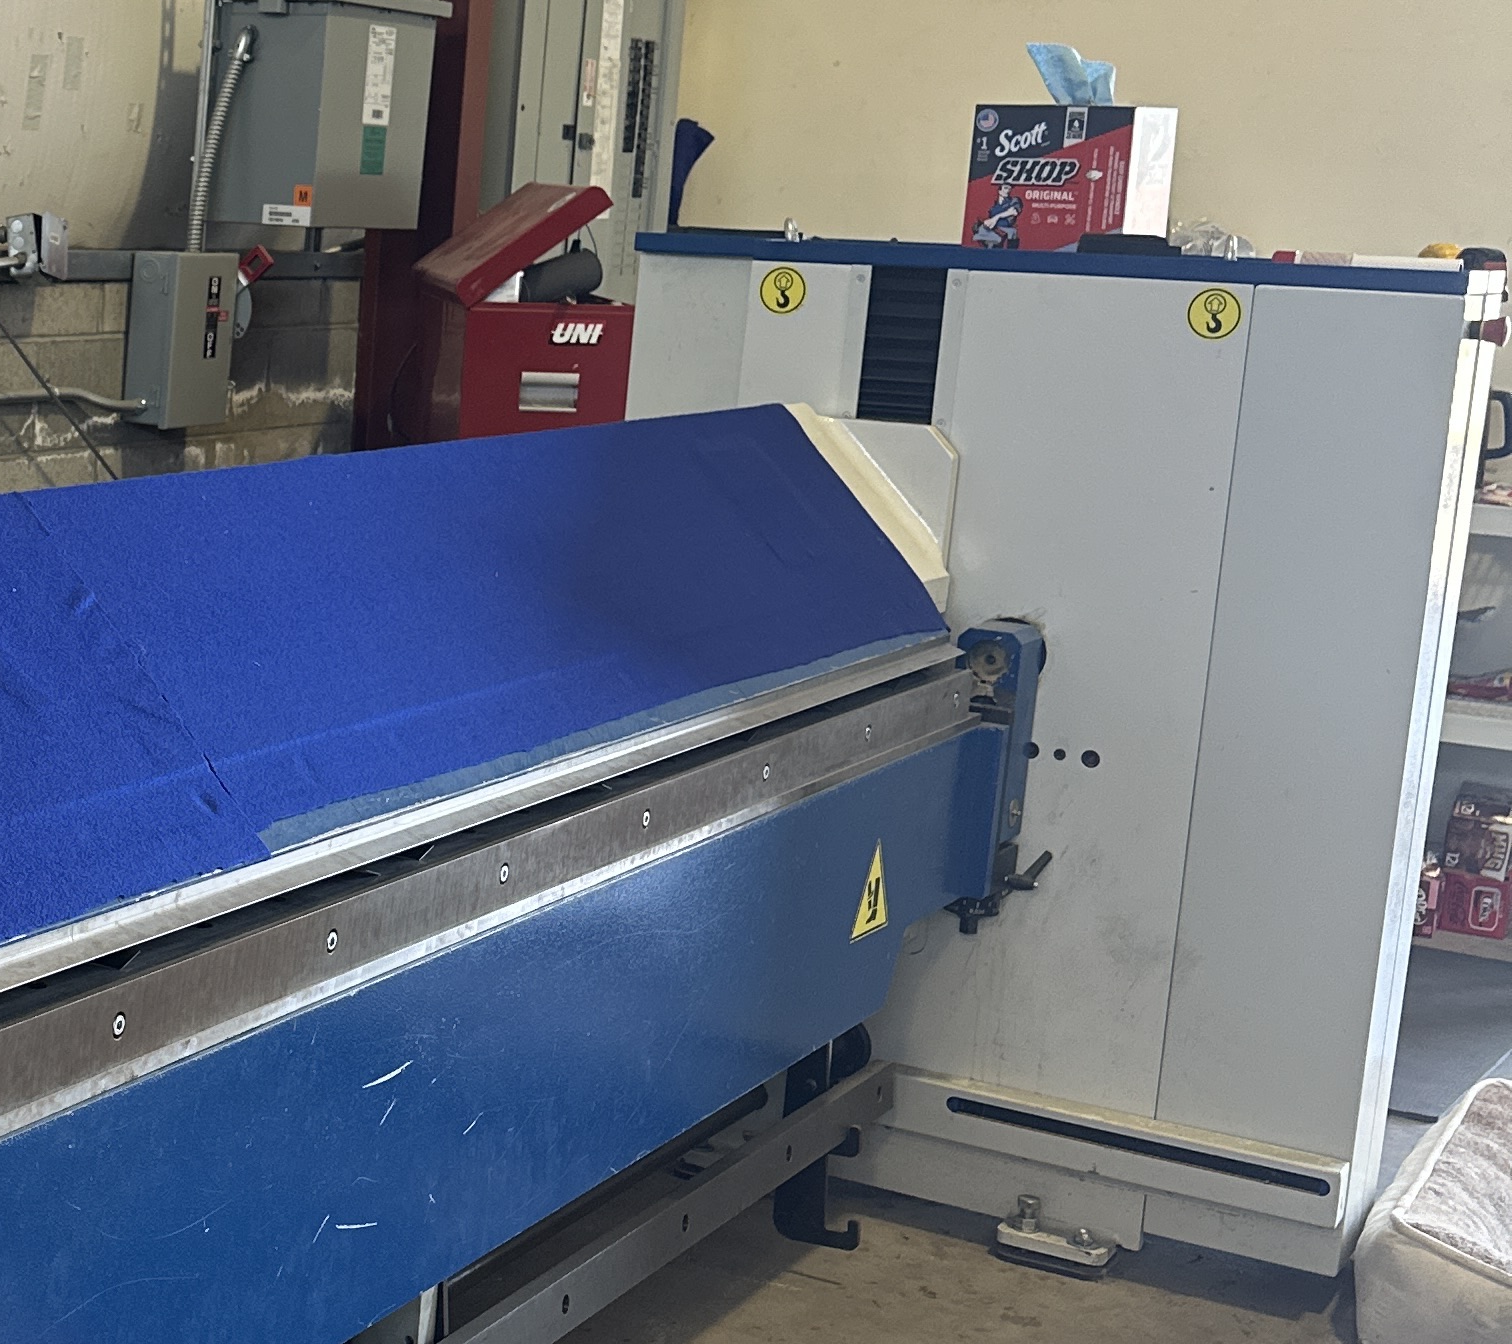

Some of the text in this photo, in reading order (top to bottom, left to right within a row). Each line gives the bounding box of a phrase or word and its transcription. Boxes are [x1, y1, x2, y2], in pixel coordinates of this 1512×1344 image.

[995, 122, 1047, 157] Scott
[991, 158, 1080, 186] SHOP
[298, 190, 308, 203] M
[1025, 190, 1075, 201] ORIGINAL
[551, 322, 604, 344] UNI
